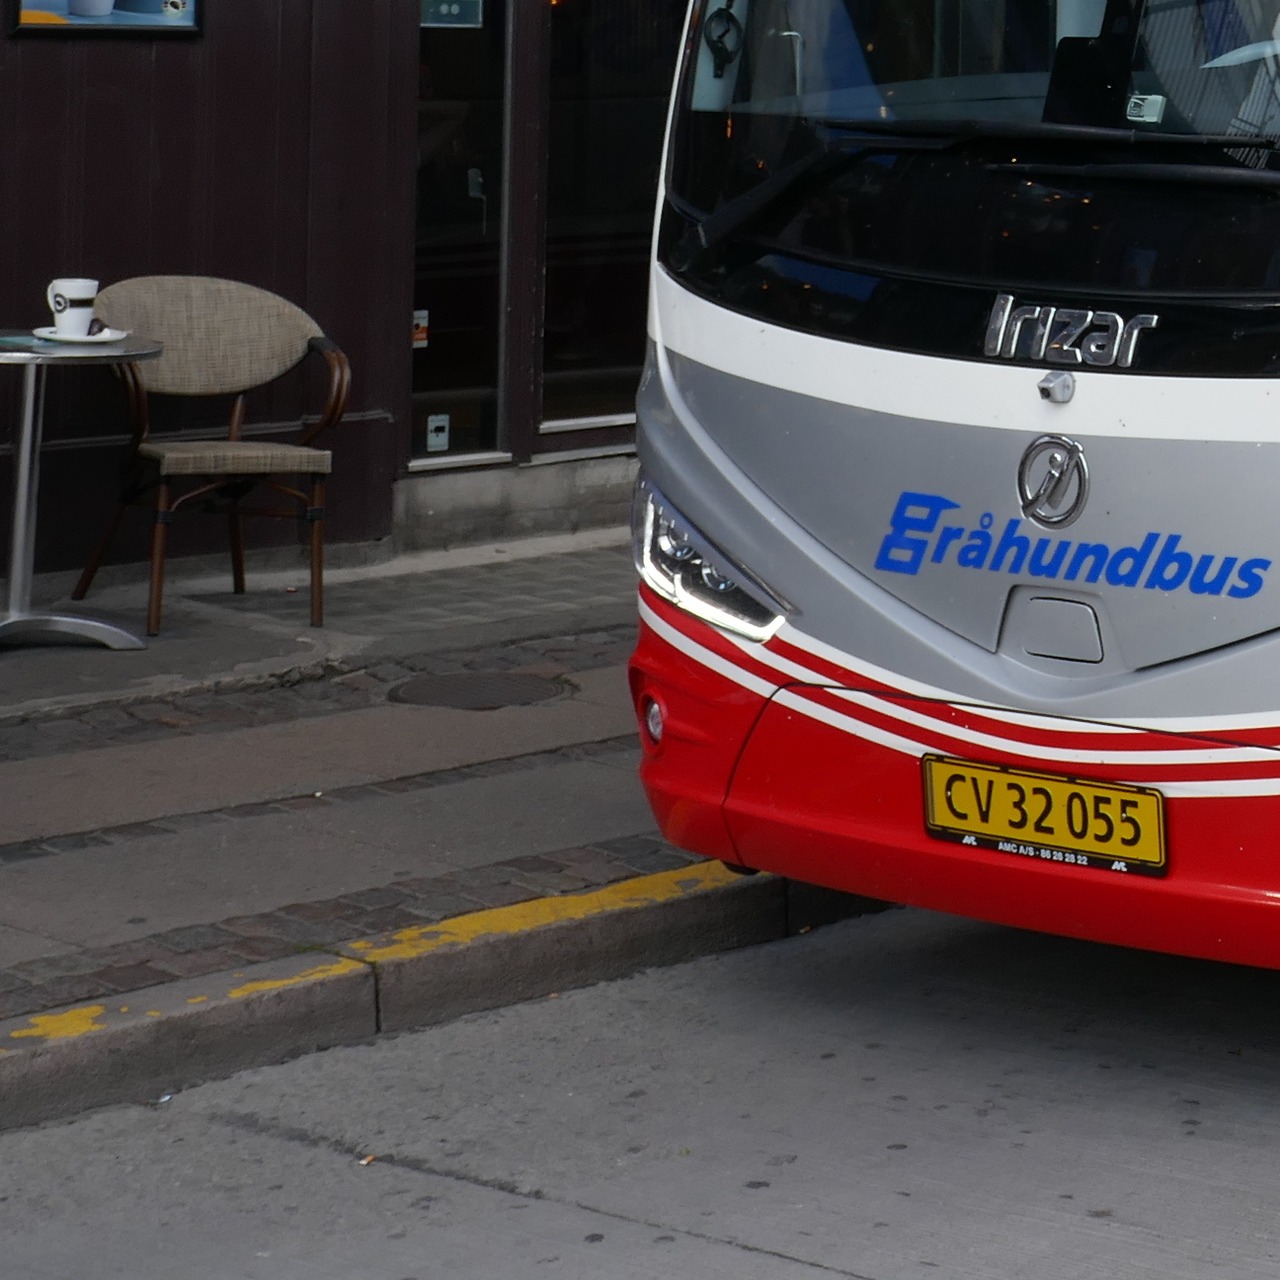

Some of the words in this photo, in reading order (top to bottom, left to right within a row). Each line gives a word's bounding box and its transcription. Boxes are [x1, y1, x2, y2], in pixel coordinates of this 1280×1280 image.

[983, 293, 1159, 368] Irizar
[944, 773, 995, 824] CV
[1006, 782, 1055, 835] 32
[1066, 791, 1142, 847] 055
[997, 841, 1018, 854] AMC
